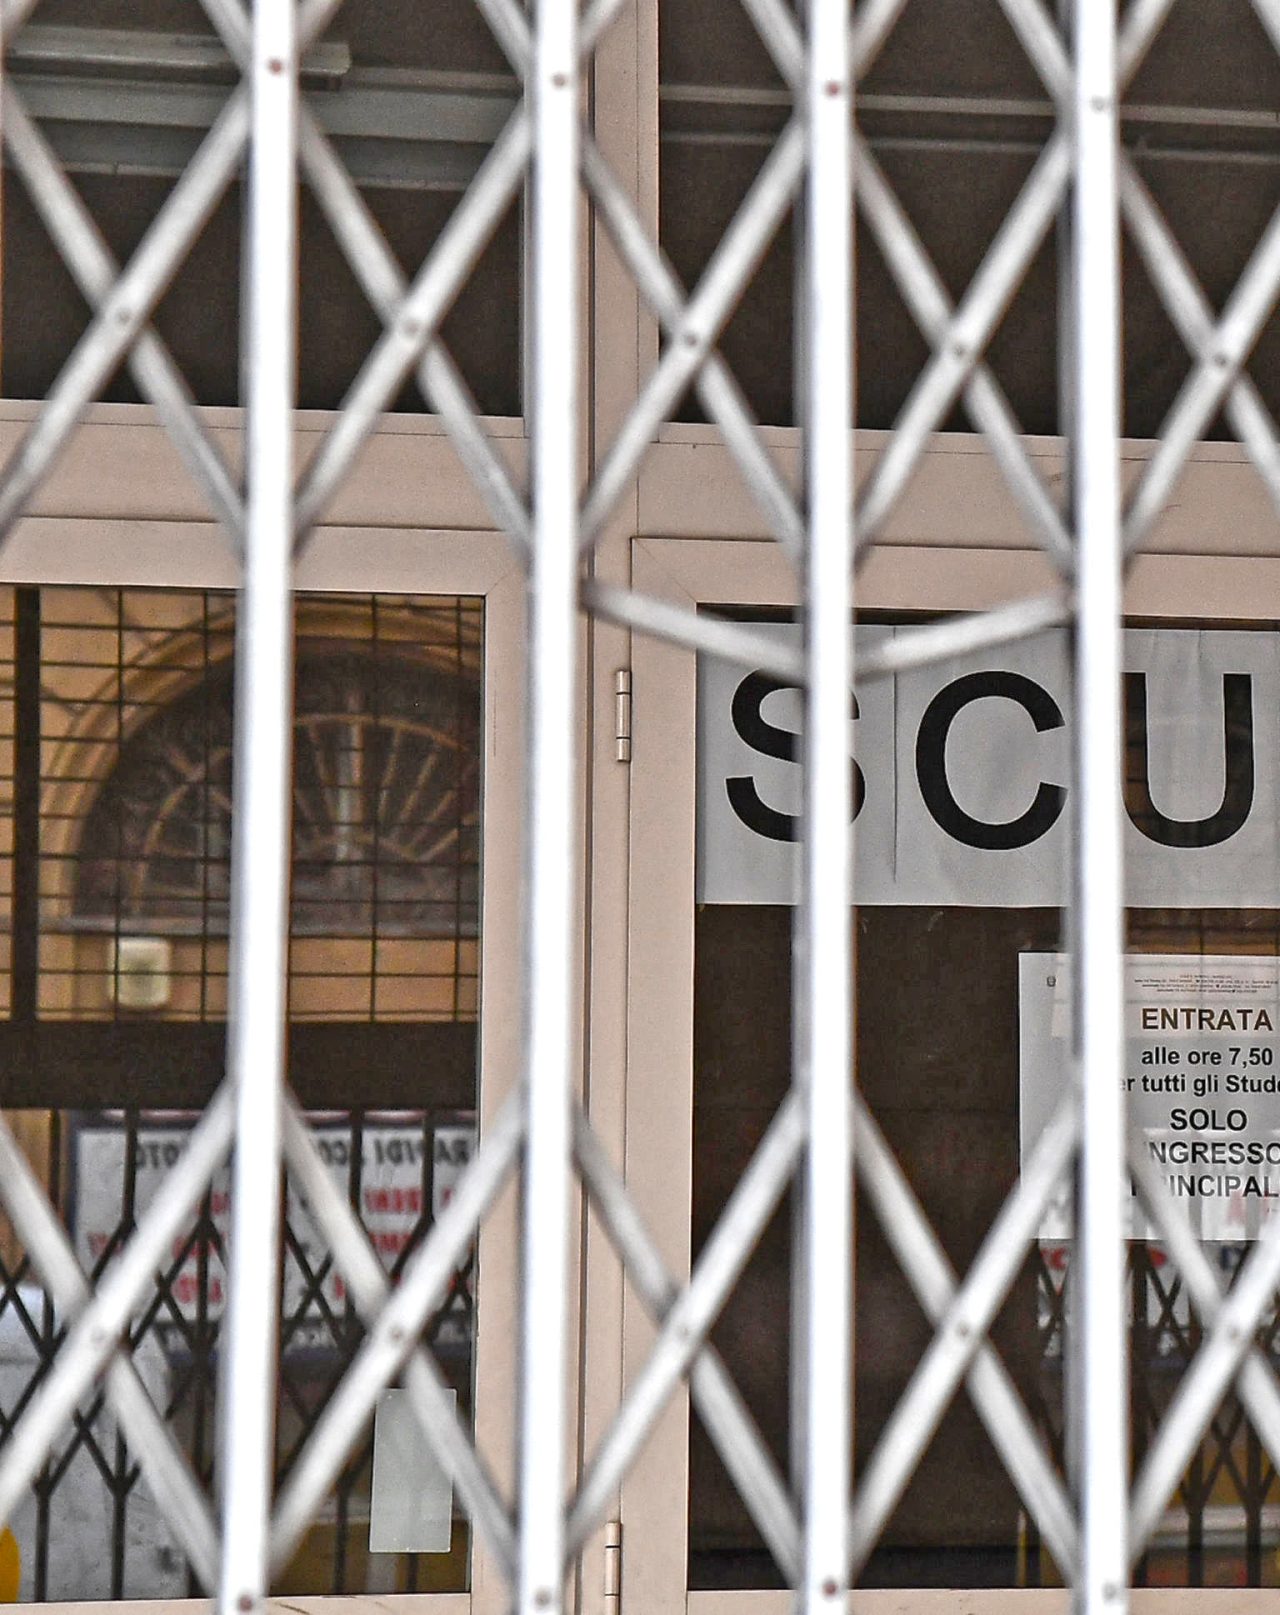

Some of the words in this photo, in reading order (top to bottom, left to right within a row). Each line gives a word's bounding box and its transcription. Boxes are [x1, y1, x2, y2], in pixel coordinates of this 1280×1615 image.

[1141, 1007, 1273, 1031] ENTRATA
[1141, 1047, 1180, 1065] alle
[1187, 1050, 1222, 1065] ore
[1228, 1047, 1273, 1068] 7,50
[1141, 1074, 1186, 1092] tutti
[1193, 1074, 1219, 1097] gli
[1169, 1108, 1247, 1131] SOLO
